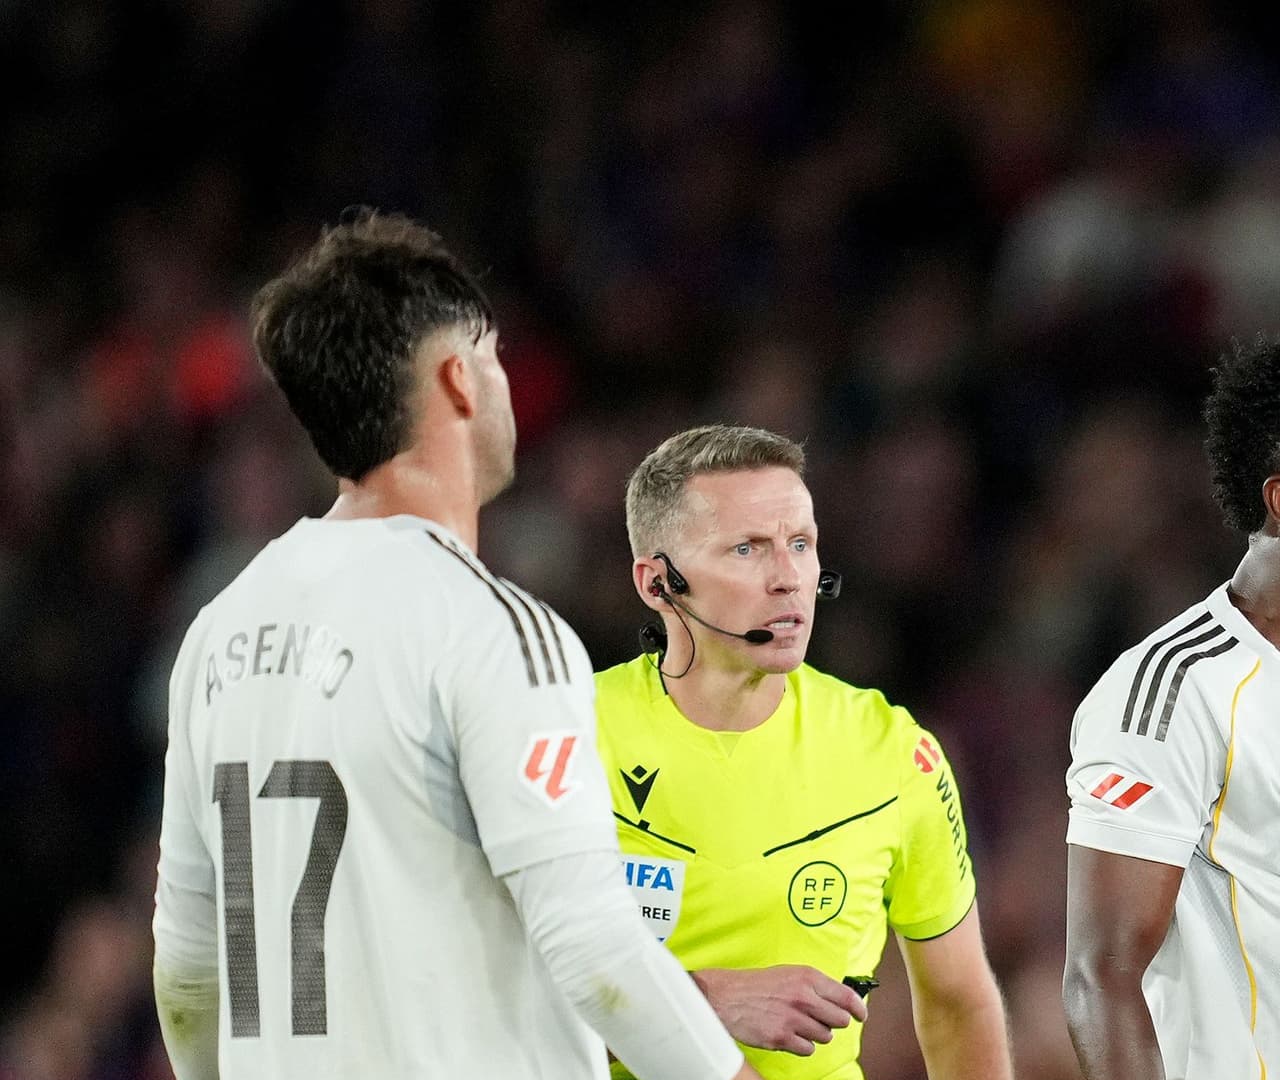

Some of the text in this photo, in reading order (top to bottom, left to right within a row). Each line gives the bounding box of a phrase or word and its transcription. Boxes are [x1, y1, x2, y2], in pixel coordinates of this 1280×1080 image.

[205, 623, 354, 707] ASENO
[211, 758, 349, 1039] 17
[625, 862, 674, 891] IFA
[640, 906, 671, 921] REE
